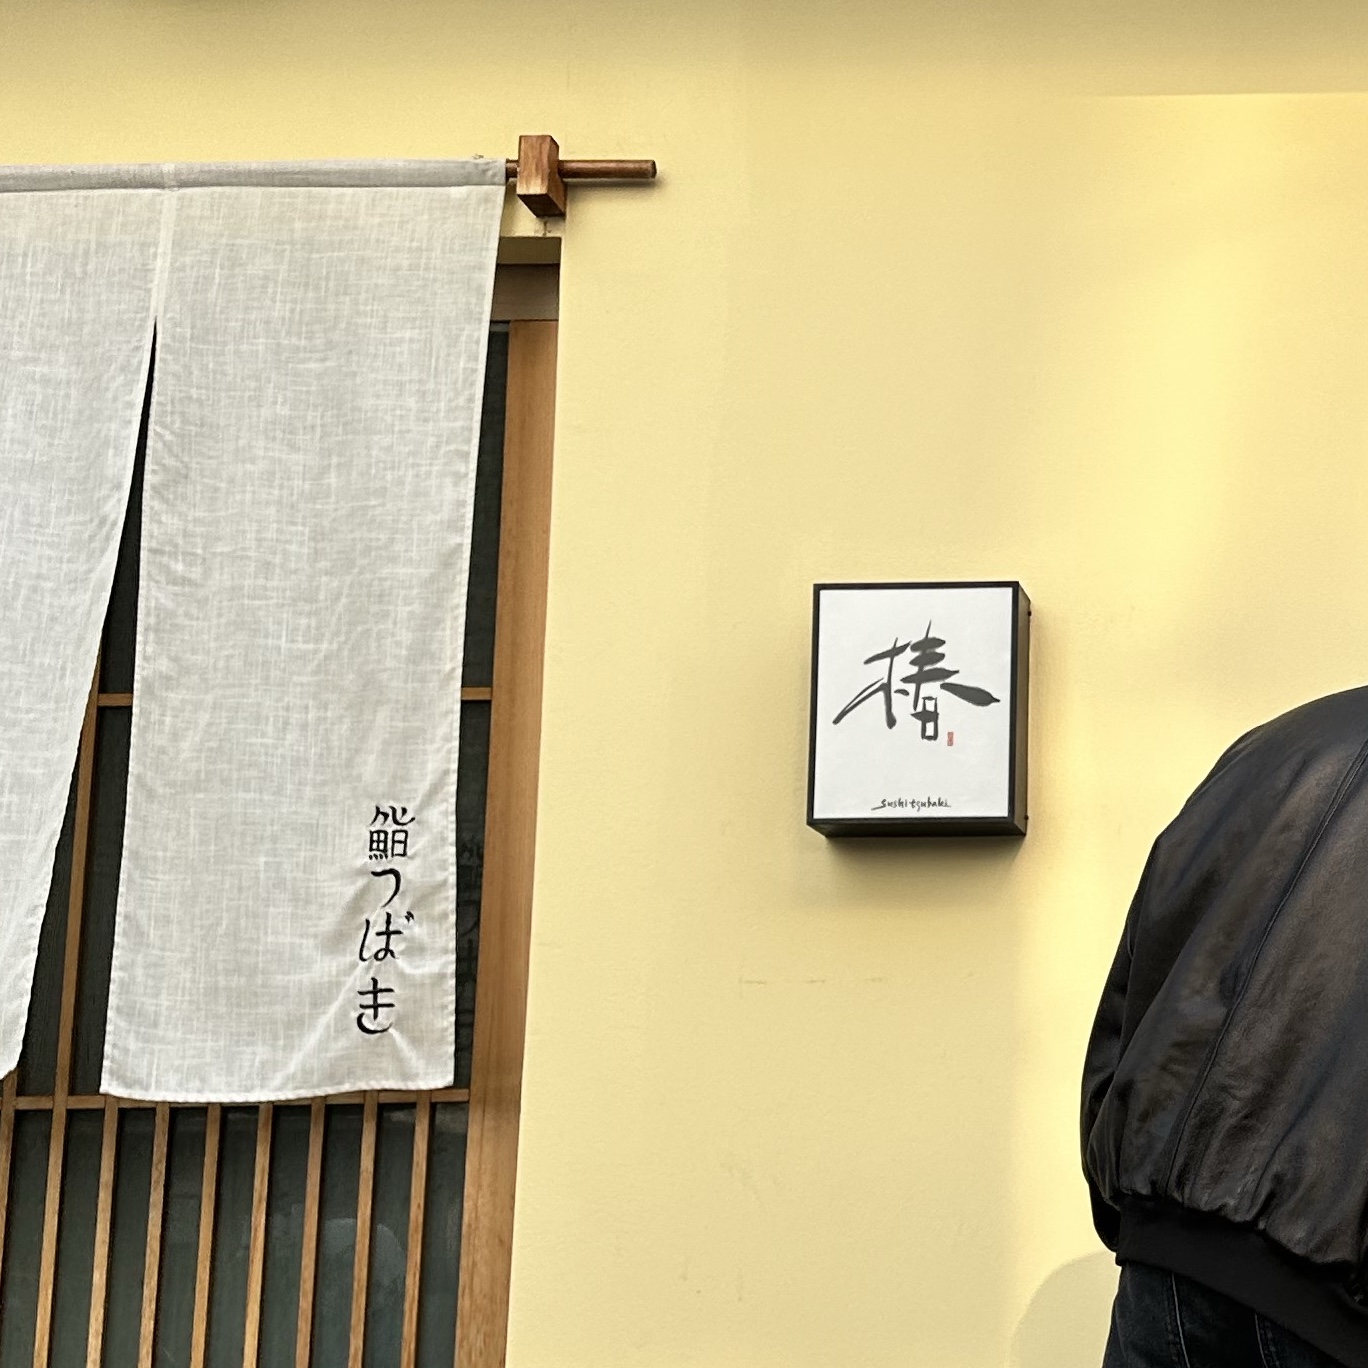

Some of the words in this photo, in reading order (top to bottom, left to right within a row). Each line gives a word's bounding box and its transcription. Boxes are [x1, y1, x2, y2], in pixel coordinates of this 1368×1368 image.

[832, 619, 1001, 742] 椿
[356, 804, 417, 1035] 鮨つばき
